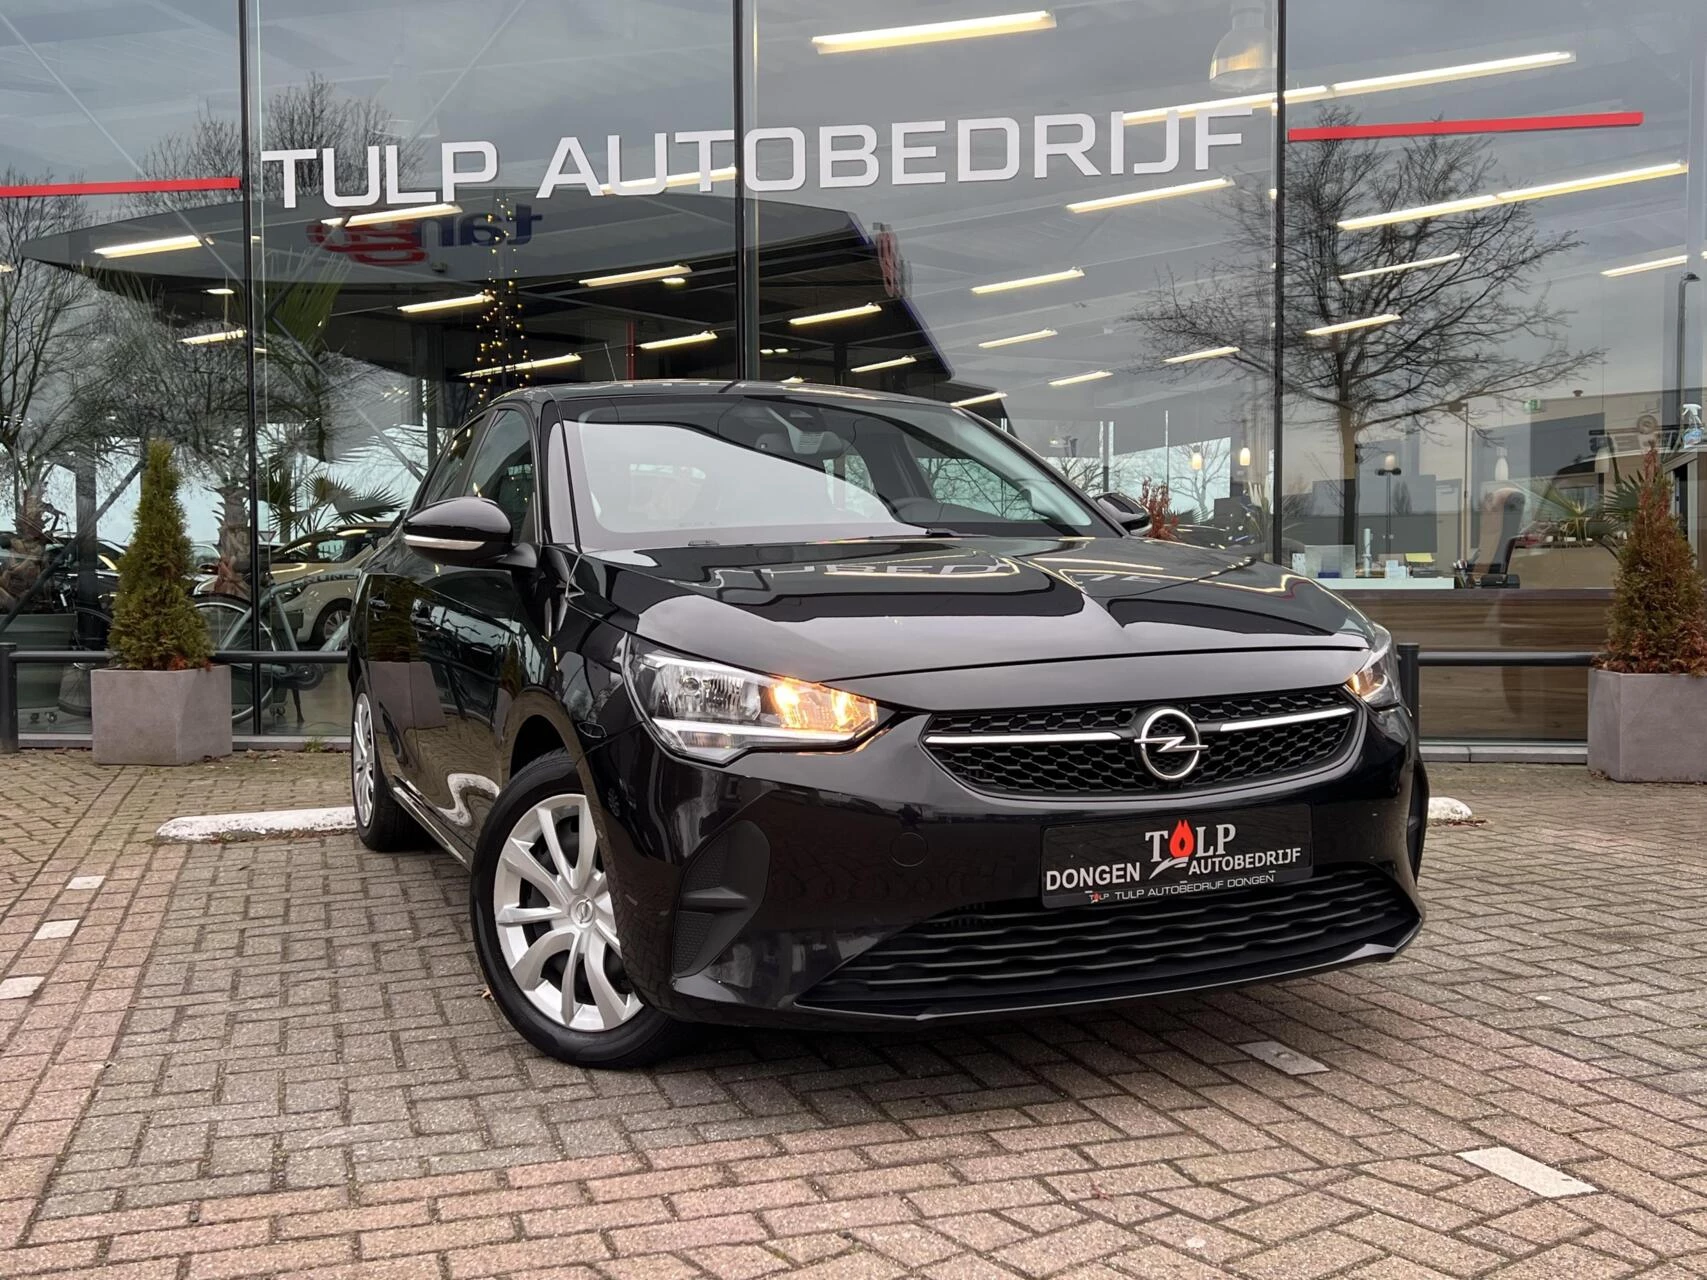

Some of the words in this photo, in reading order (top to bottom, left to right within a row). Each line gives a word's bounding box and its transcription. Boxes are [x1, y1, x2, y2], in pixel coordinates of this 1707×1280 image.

[261, 141, 497, 208] TULP
[536, 106, 1253, 199] AUTOBEDRIJF
[1046, 862, 1140, 891] DONGEN
[1188, 848, 1301, 875] AUTOBEDRIJF
[1115, 890, 1145, 900] TULP
[1148, 881, 1224, 896] AUTOBEDRIJF
[1227, 875, 1275, 888] DONGEN
